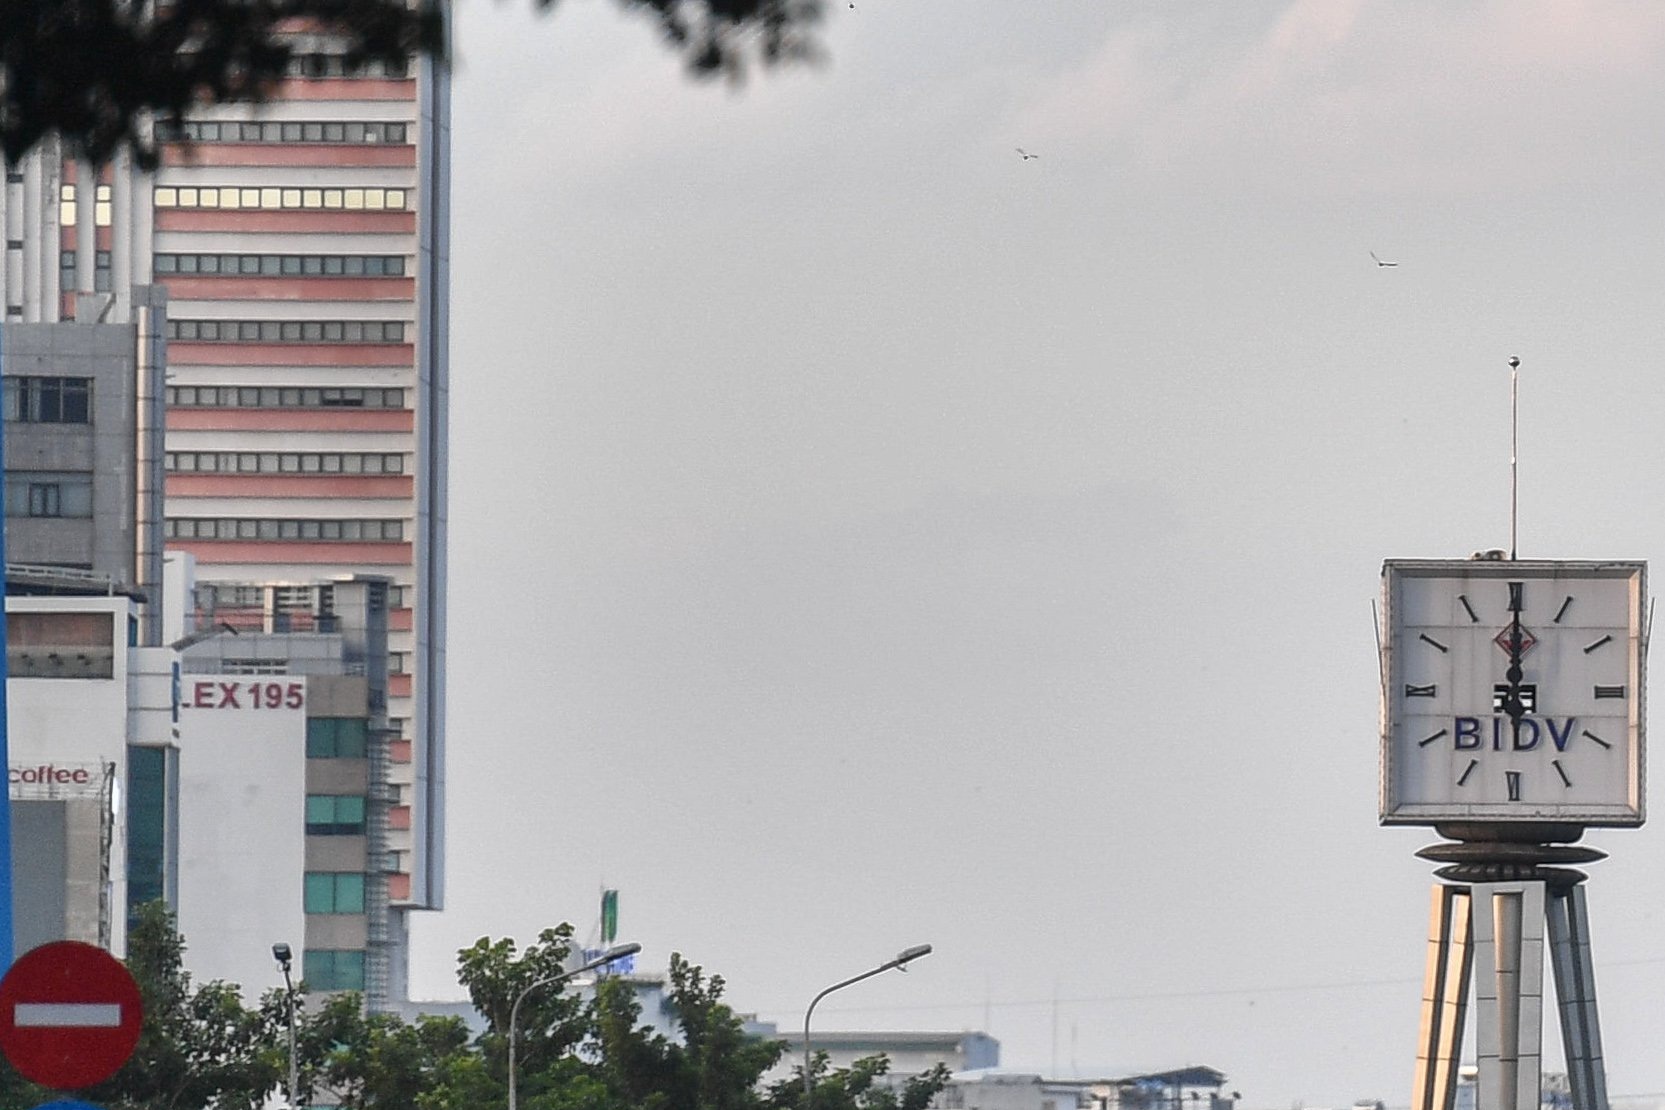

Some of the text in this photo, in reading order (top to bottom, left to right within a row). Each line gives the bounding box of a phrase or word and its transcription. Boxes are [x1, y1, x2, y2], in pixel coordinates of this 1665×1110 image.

[248, 683, 304, 709] 195
[1453, 716, 1575, 751] BIDV
[9, 764, 89, 785] coffee
